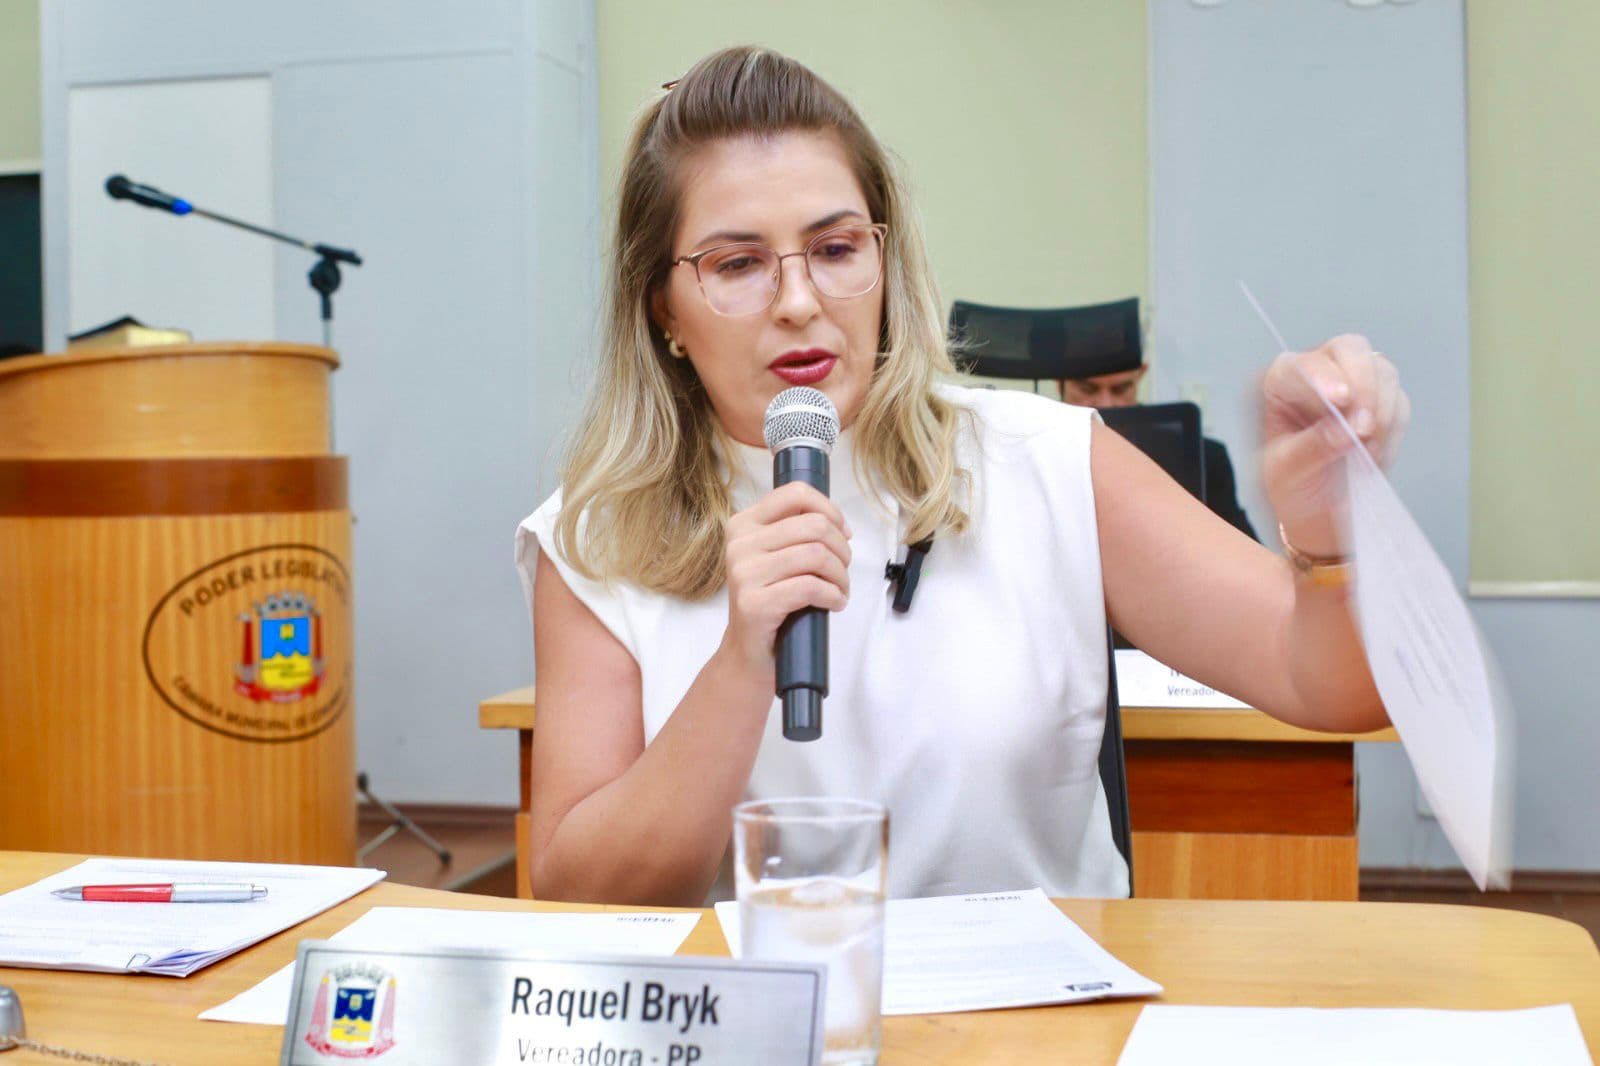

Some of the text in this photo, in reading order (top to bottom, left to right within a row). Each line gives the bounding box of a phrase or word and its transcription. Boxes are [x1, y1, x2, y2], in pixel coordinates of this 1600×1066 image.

[179, 565, 256, 616] PODER
[510, 976, 720, 1034] Raquel Bryk
[517, 1038, 643, 1066] Vereadora
[668, 1043, 702, 1066] PP
